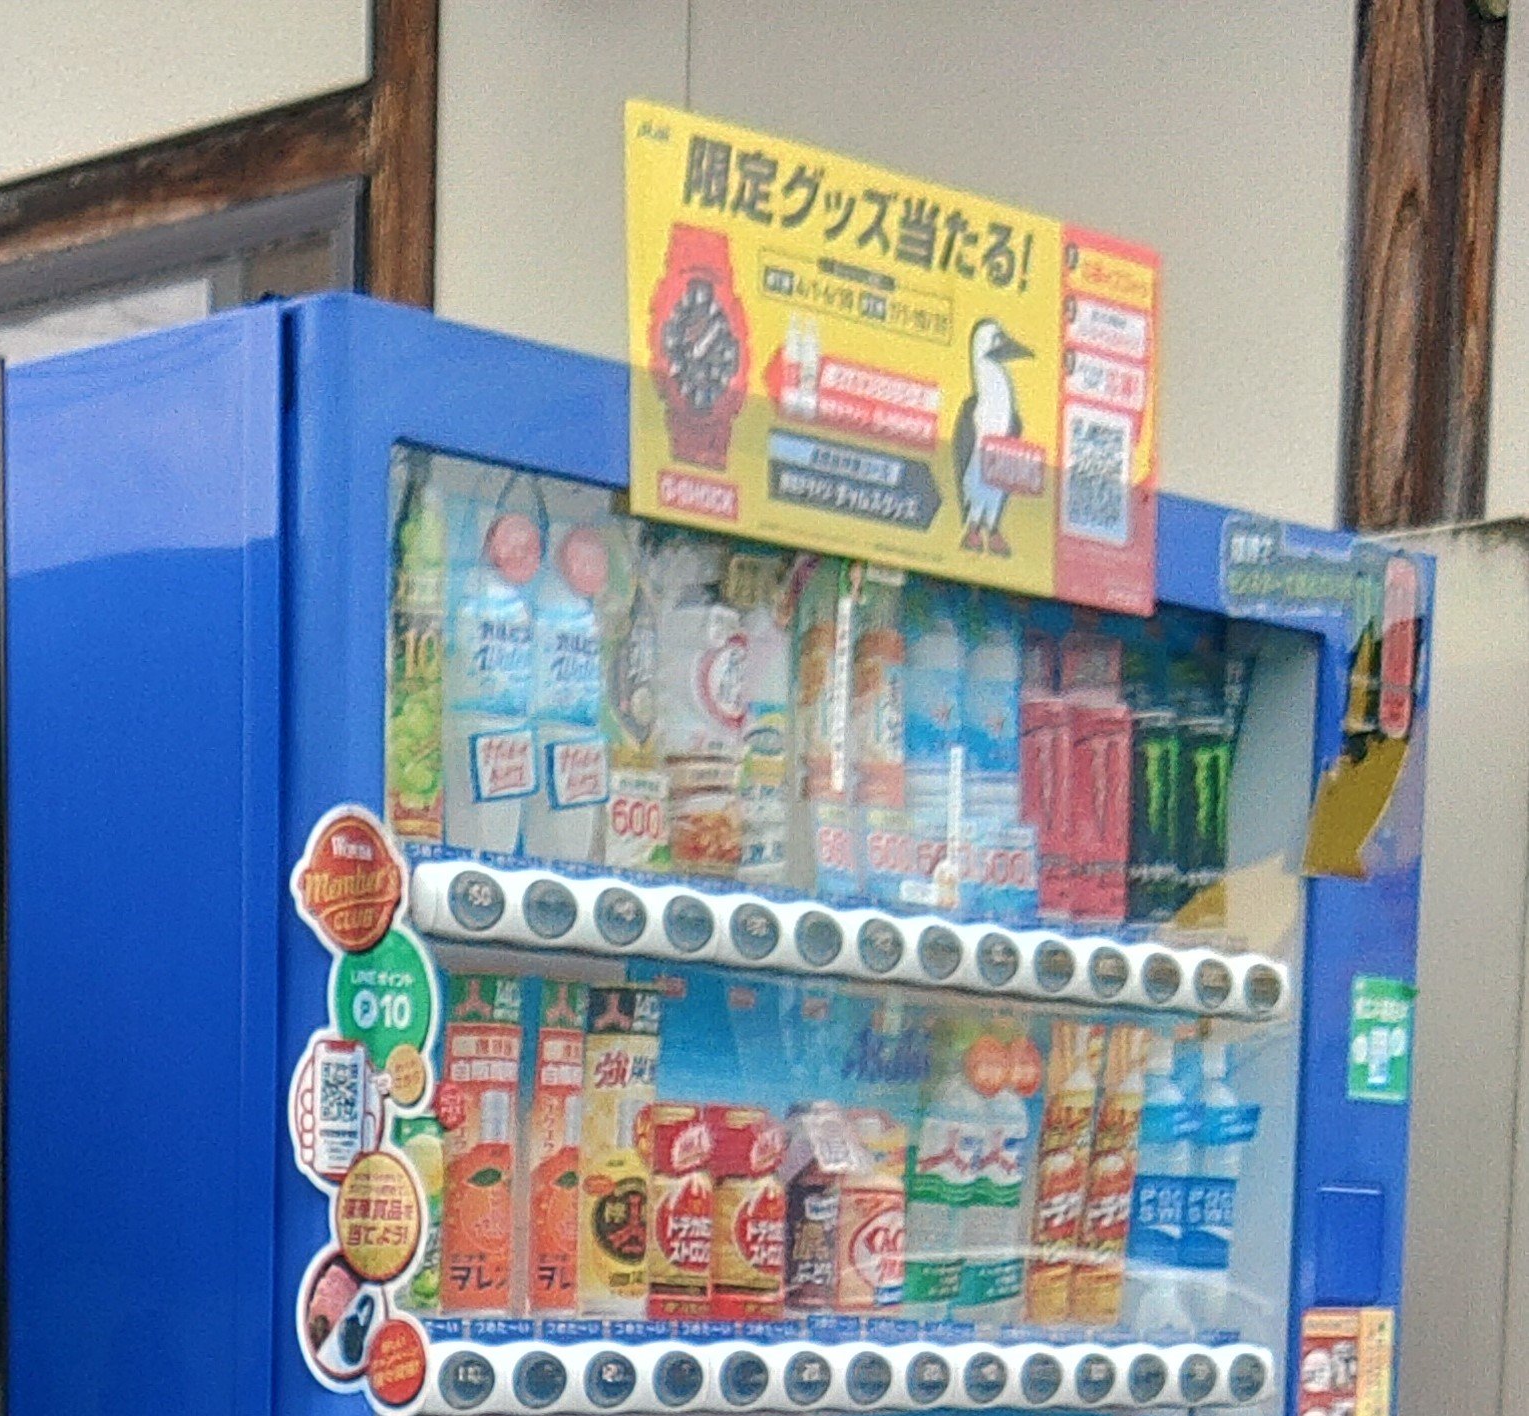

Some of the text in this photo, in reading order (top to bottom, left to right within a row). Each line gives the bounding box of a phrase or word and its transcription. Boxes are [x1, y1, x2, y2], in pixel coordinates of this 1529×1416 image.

[683, 134, 1035, 294] 限定グッズ当たる!
